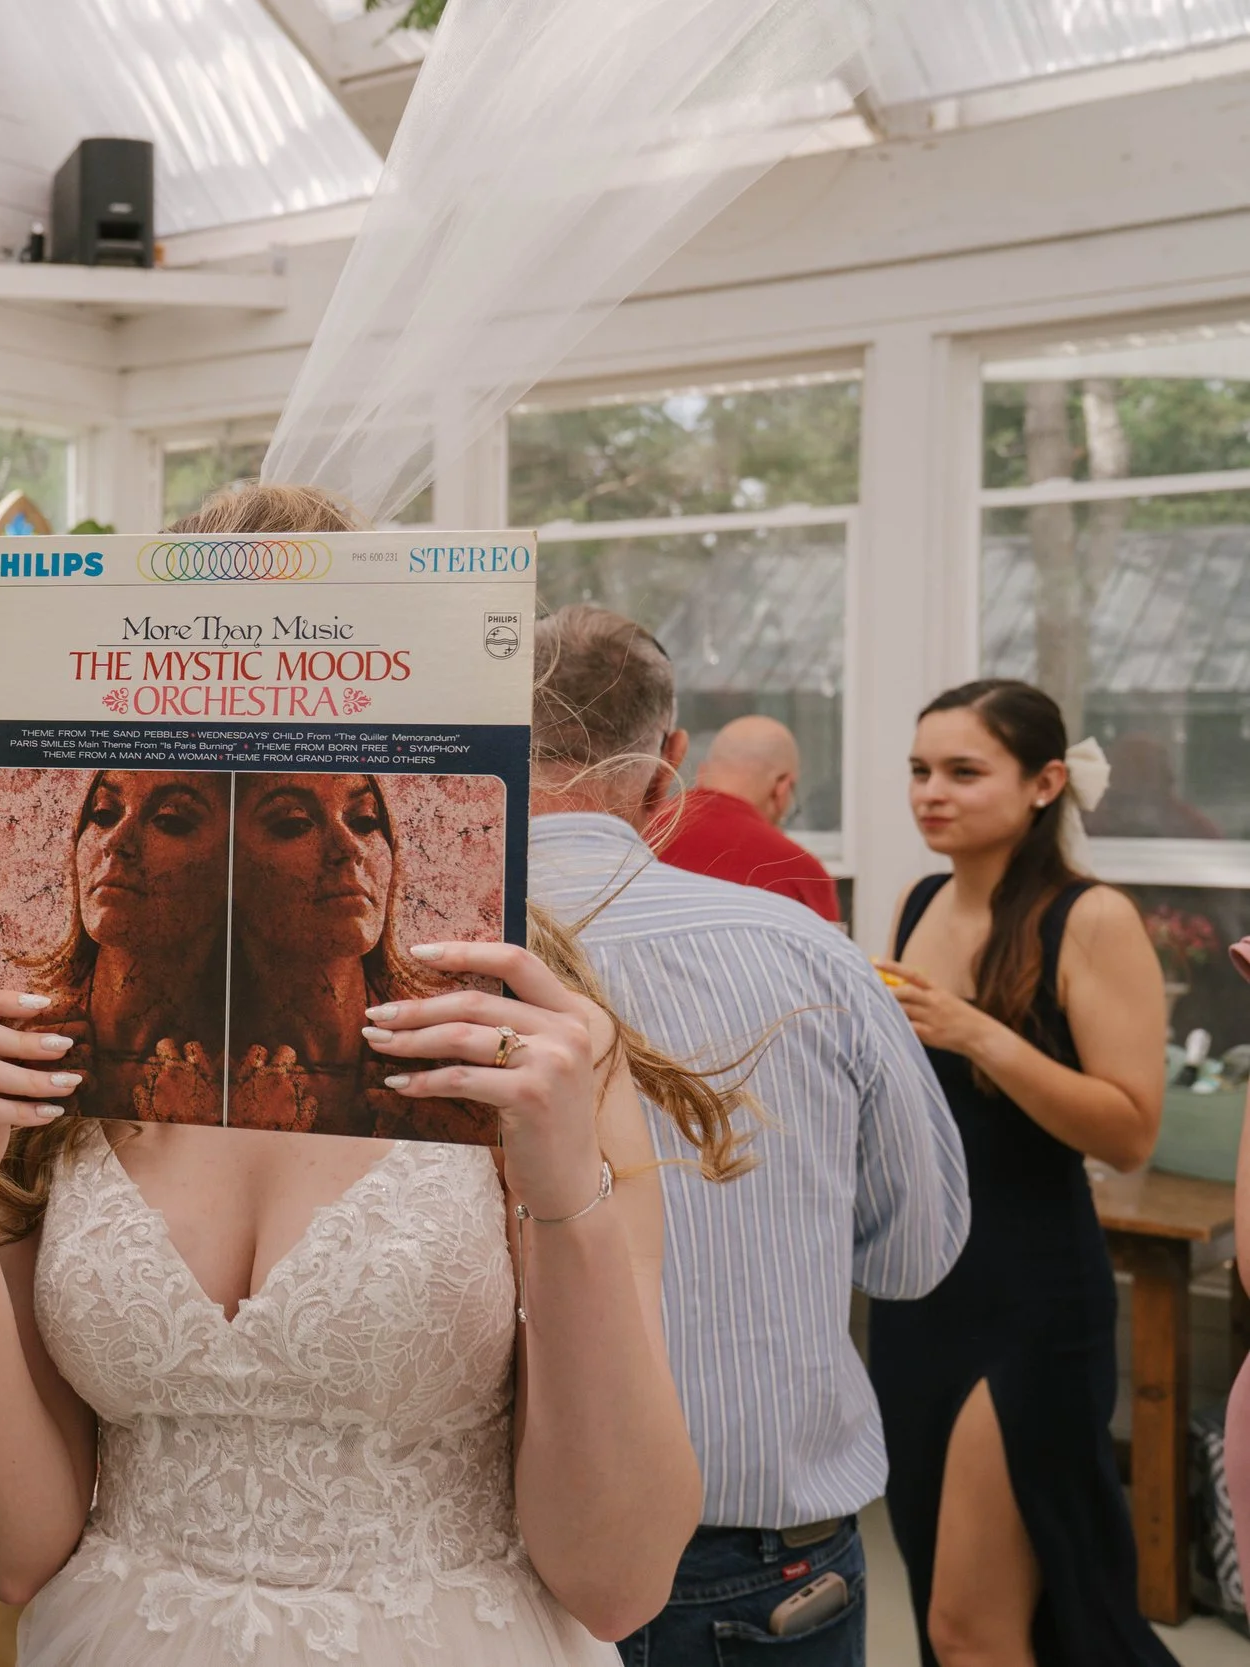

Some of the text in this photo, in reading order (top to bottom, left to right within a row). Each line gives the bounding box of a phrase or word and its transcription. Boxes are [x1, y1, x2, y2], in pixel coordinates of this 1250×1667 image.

[352, 552, 367, 561] PHS
[409, 546, 530, 573] STEREO
[487, 615, 518, 624] PHILIPS
[122, 616, 354, 648] More Than Music
[69, 650, 411, 681] THE MYSTIC MOODS
[133, 685, 339, 717] ORCHESTRA
[21, 729, 55, 737] THEME
[58, 730, 87, 738] FROM
[90, 730, 110, 738] THE
[113, 730, 141, 738] SAND
[144, 730, 189, 739] PEBBLES
[272, 732, 304, 740] CHILD
[307, 732, 331, 740] From
[334, 733, 357, 741] "The
[359, 733, 389, 742] Quiller
[392, 733, 461, 742] Memorandum"
[10, 740, 38, 748] PARIS
[40, 740, 76, 748] SMILES
[78, 740, 100, 748] Main
[102, 741, 132, 749] Theme
[134, 741, 158, 749] From
[174, 742, 197, 750] Paris
[199, 742, 238, 752] Burning"
[255, 743, 291, 751] THEME
[294, 743, 325, 751] FROM
[328, 744, 358, 752] BORN
[361, 744, 389, 752] FREE
[409, 745, 471, 753] SYMPHONY
[43, 751, 76, 759] THEME
[78, 751, 107, 759] FROM
[119, 752, 142, 760] MAN
[144, 752, 166, 760] AND
[177, 753, 218, 761] WOMAN
[225, 753, 261, 762] THEME
[263, 754, 293, 762] FROM
[295, 754, 333, 763] GRAND
[335, 755, 359, 763] PRIX
[366, 755, 390, 763] AND
[392, 756, 436, 764] OTHERS
